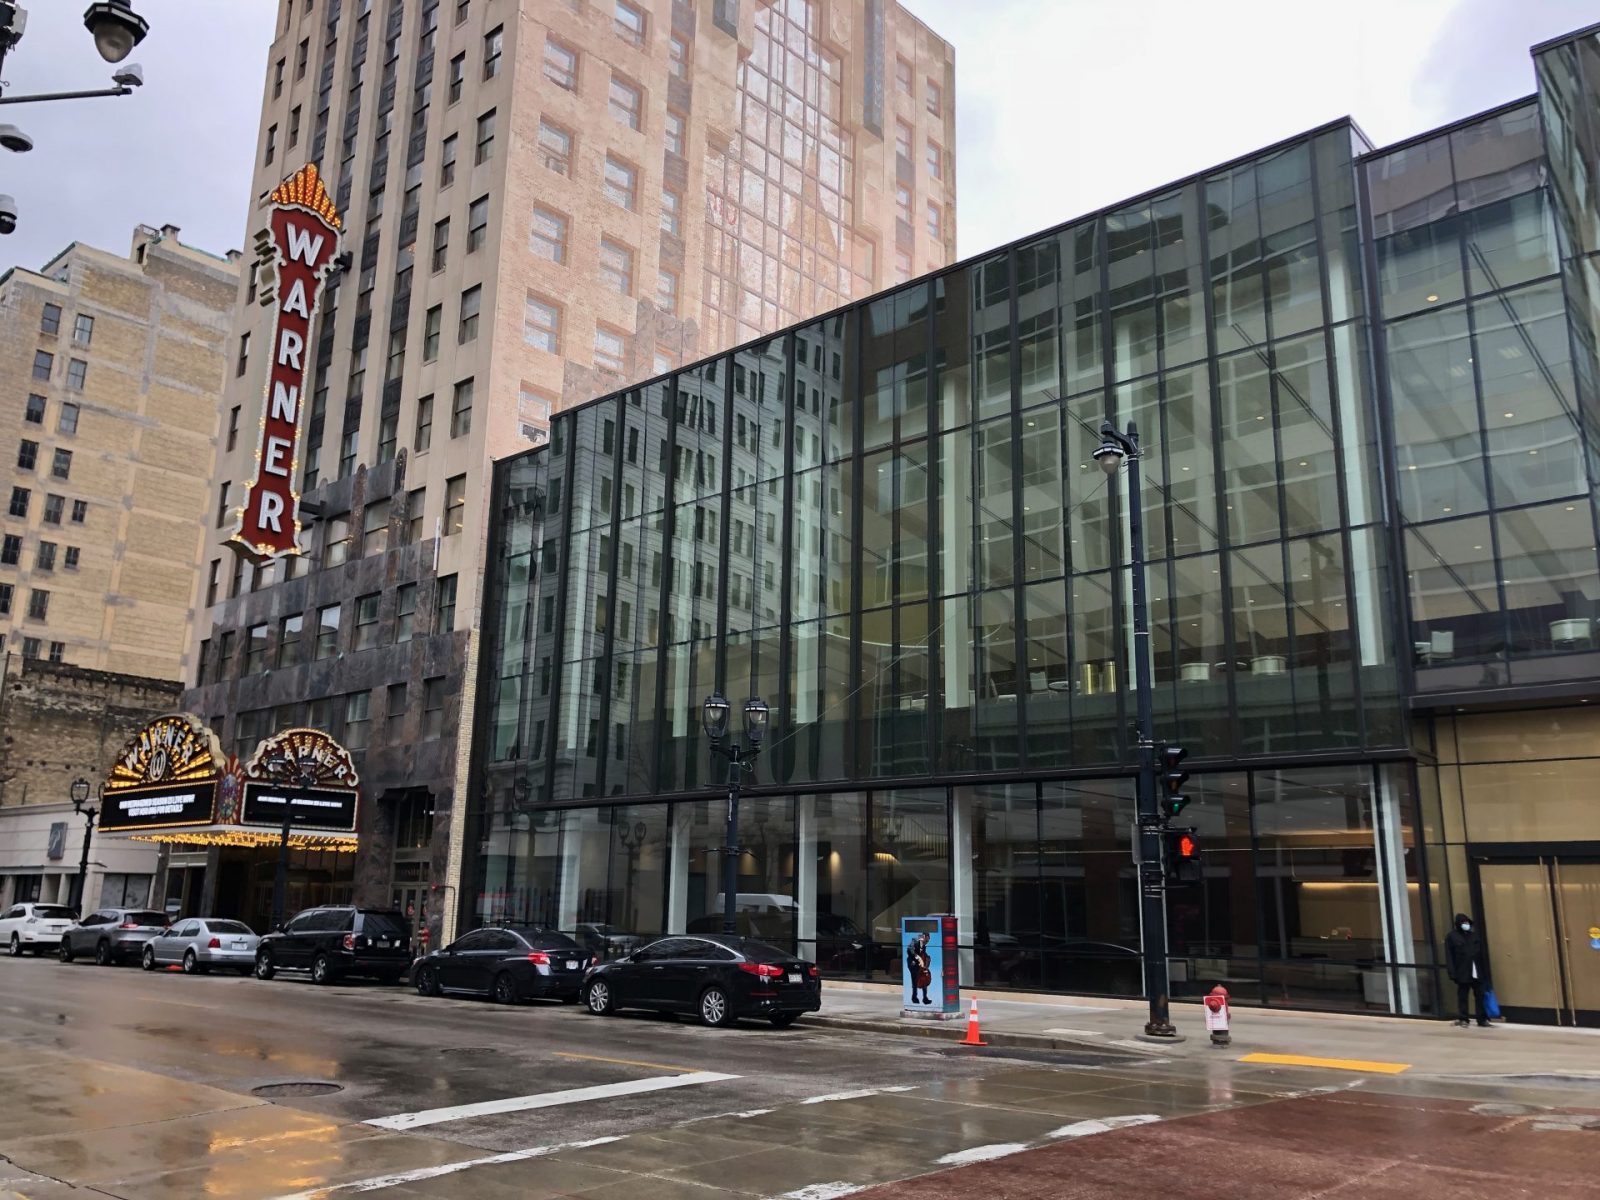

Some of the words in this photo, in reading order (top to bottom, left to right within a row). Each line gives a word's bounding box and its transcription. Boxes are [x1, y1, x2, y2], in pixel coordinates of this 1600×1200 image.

[257, 222, 325, 534] WARNER
[125, 726, 193, 770] WARNER
[267, 745, 348, 779] ARNER
